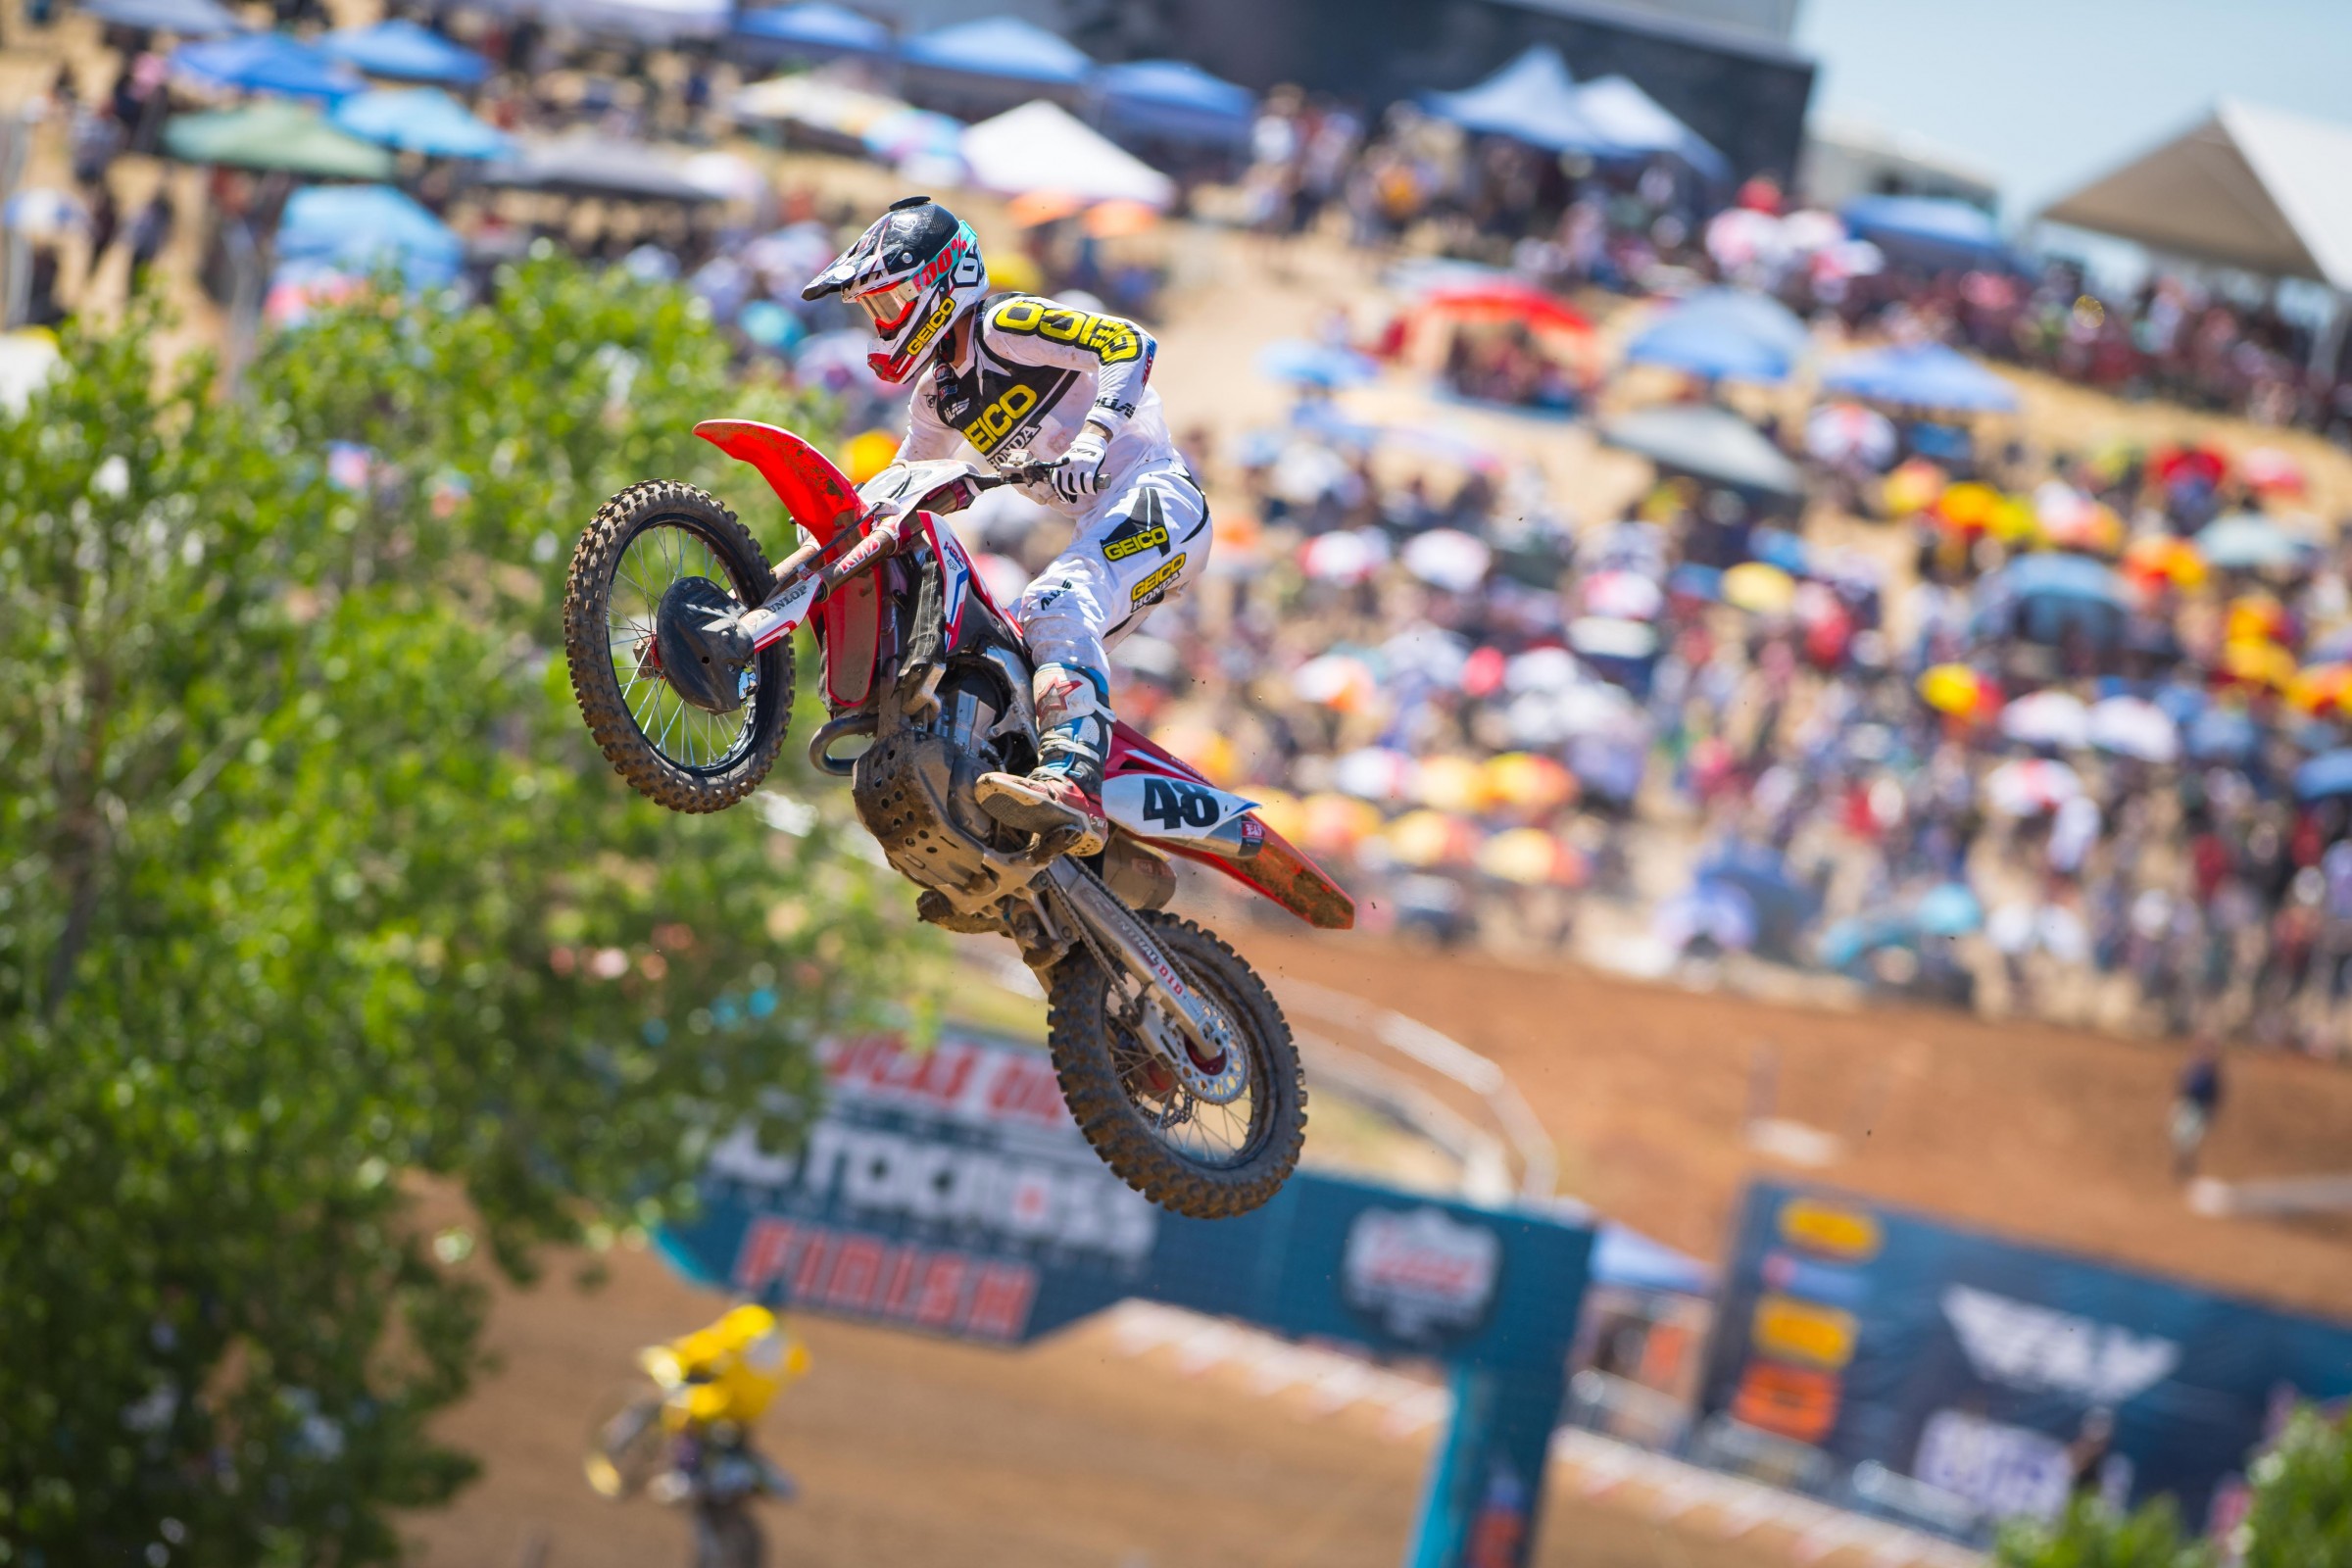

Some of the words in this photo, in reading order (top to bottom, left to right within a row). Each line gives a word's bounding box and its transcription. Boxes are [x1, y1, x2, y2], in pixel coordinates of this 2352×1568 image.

[906, 297, 956, 356] GEICO
[995, 300, 1138, 363] GEICO
[960, 384, 1037, 453] EICO
[1102, 525, 1169, 562] GEICO
[759, 585, 808, 621] DUNLOP
[1131, 553, 1186, 602] GEICO
[1132, 570, 1181, 612] HONDA
[1143, 777, 1220, 830] 48
[737, 1217, 1037, 1339] FINISH
